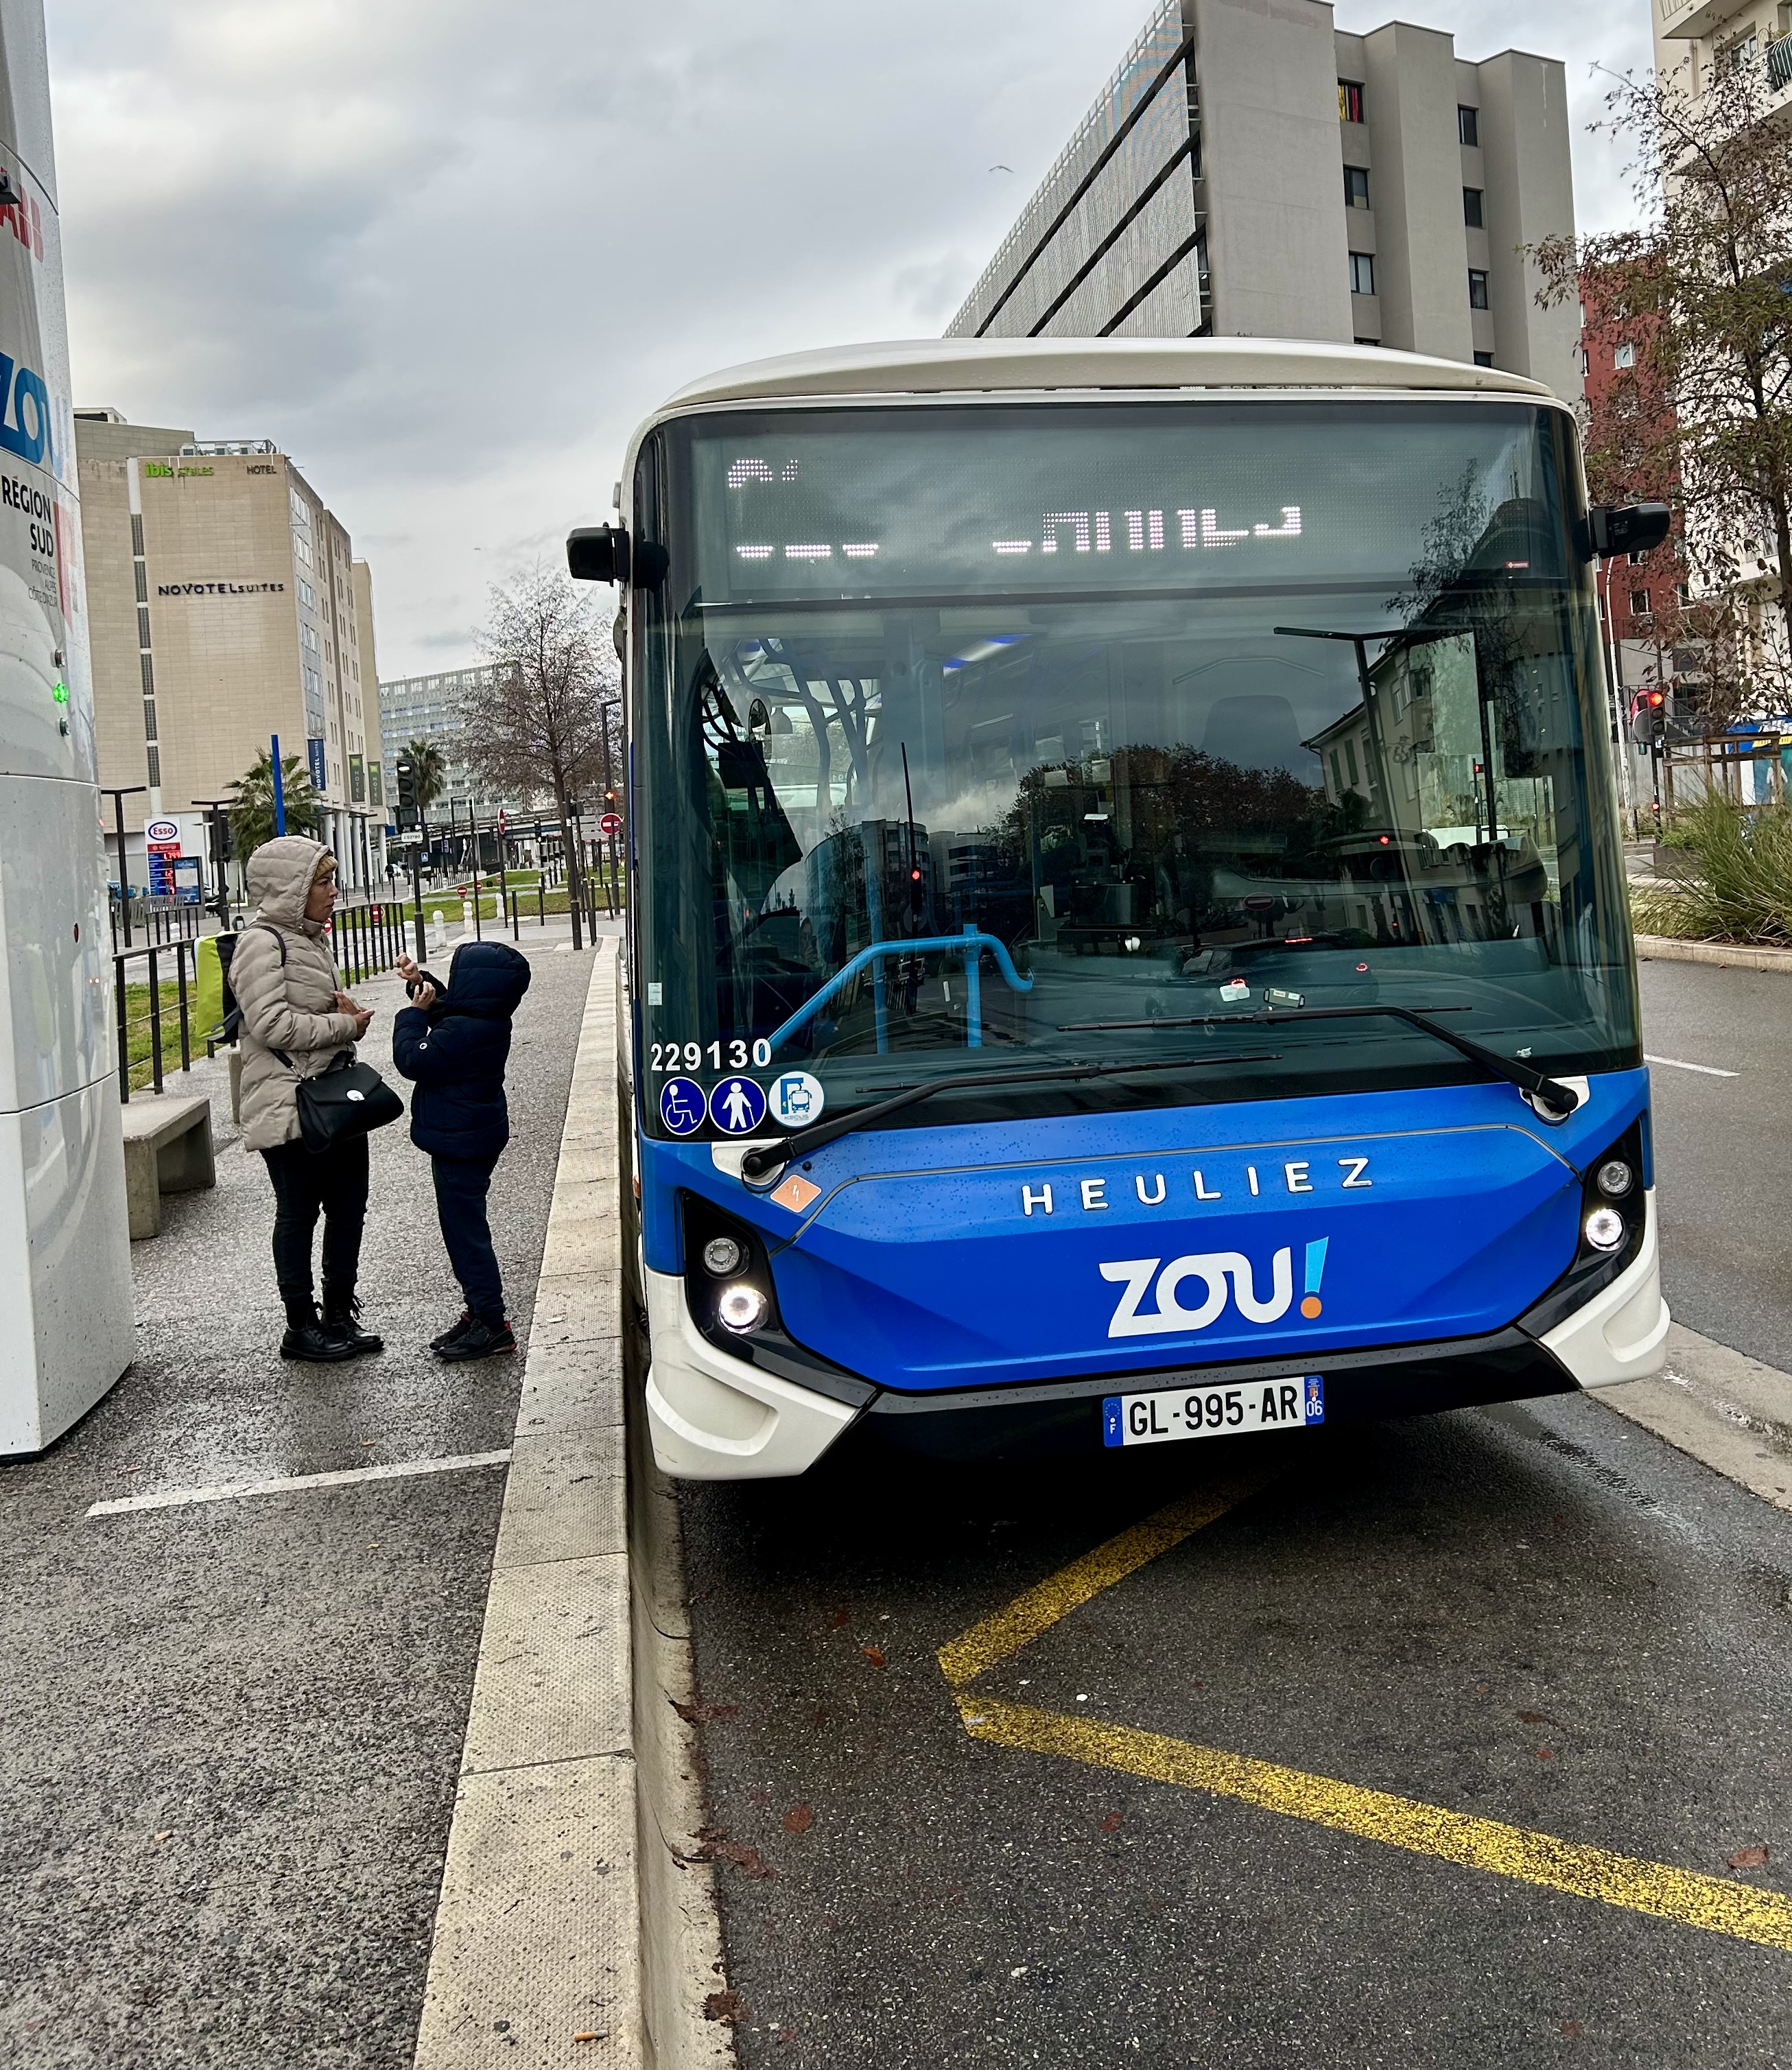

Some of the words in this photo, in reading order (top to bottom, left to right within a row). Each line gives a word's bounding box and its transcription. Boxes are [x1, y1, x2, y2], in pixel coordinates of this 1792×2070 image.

[145, 461, 172, 477] ibis
[246, 464, 276, 475] HOTEL
[1, 475, 51, 524] RÉGION
[30, 523, 54, 557] SUD
[153, 827, 174, 835] Esso
[650, 1038, 773, 1071] 229130
[1022, 1157, 1373, 1216] HEULIEZ
[1098, 1236, 1330, 1338] ZOU!
[1129, 1385, 1298, 1436] GL-995-AR
[1306, 1400, 1323, 1417] 06
